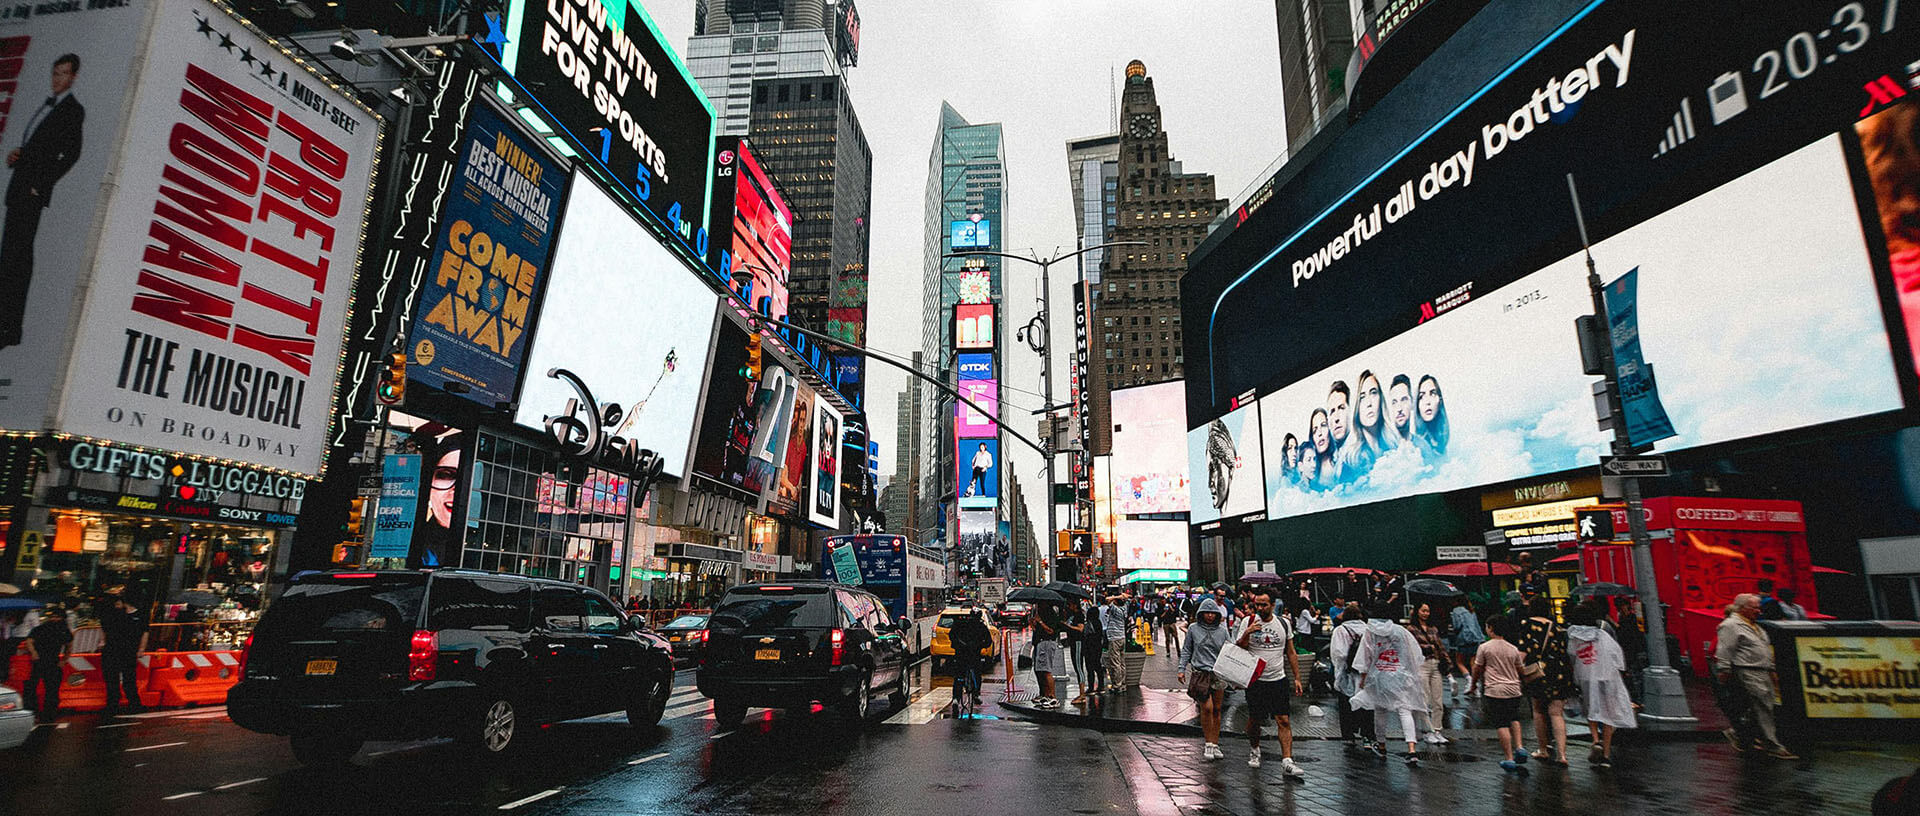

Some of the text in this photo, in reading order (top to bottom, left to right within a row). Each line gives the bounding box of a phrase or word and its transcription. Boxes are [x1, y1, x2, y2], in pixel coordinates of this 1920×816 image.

[547, 0, 630, 97] LIVE TV
[612, 19, 658, 98] WITH
[277, 70, 289, 92] A
[542, 20, 669, 183] FOR SPORTS.
[468, 138, 551, 221] BEST MUSICAL
[495, 131, 543, 187] WINNER!
[718, 167, 732, 177] LG
[1291, 28, 1636, 288] Powerful all day battery
[130, 62, 275, 342] WOMAN
[463, 164, 548, 234] ALL ACROSS NORTH AMERICA
[230, 110, 349, 377] PRETTY
[449, 220, 537, 296] COME
[436, 250, 531, 328] FROM
[1435, 281, 1474, 305] MARRIOTT
[1436, 292, 1471, 314] MARQUIS
[424, 292, 522, 358] AWAY
[117, 327, 306, 430] THE MUSICAL
[967, 363, 990, 372] TDK
[1076, 302, 1089, 440] COMMUNICATE
[107, 406, 300, 458] ON BROADWAY
[751, 366, 799, 469] 21
[70, 442, 307, 500] GIFTS LUGGAGE
[382, 489, 416, 497] MUSICAL
[1514, 481, 1571, 502] INVICTA
[1610, 460, 1659, 471] ONE WAY
[117, 495, 158, 511] Nikon
[194, 488, 224, 504] NY
[219, 508, 262, 521] SONY
[379, 507, 403, 515] DEAR
[377, 521, 412, 530] HANSEN
